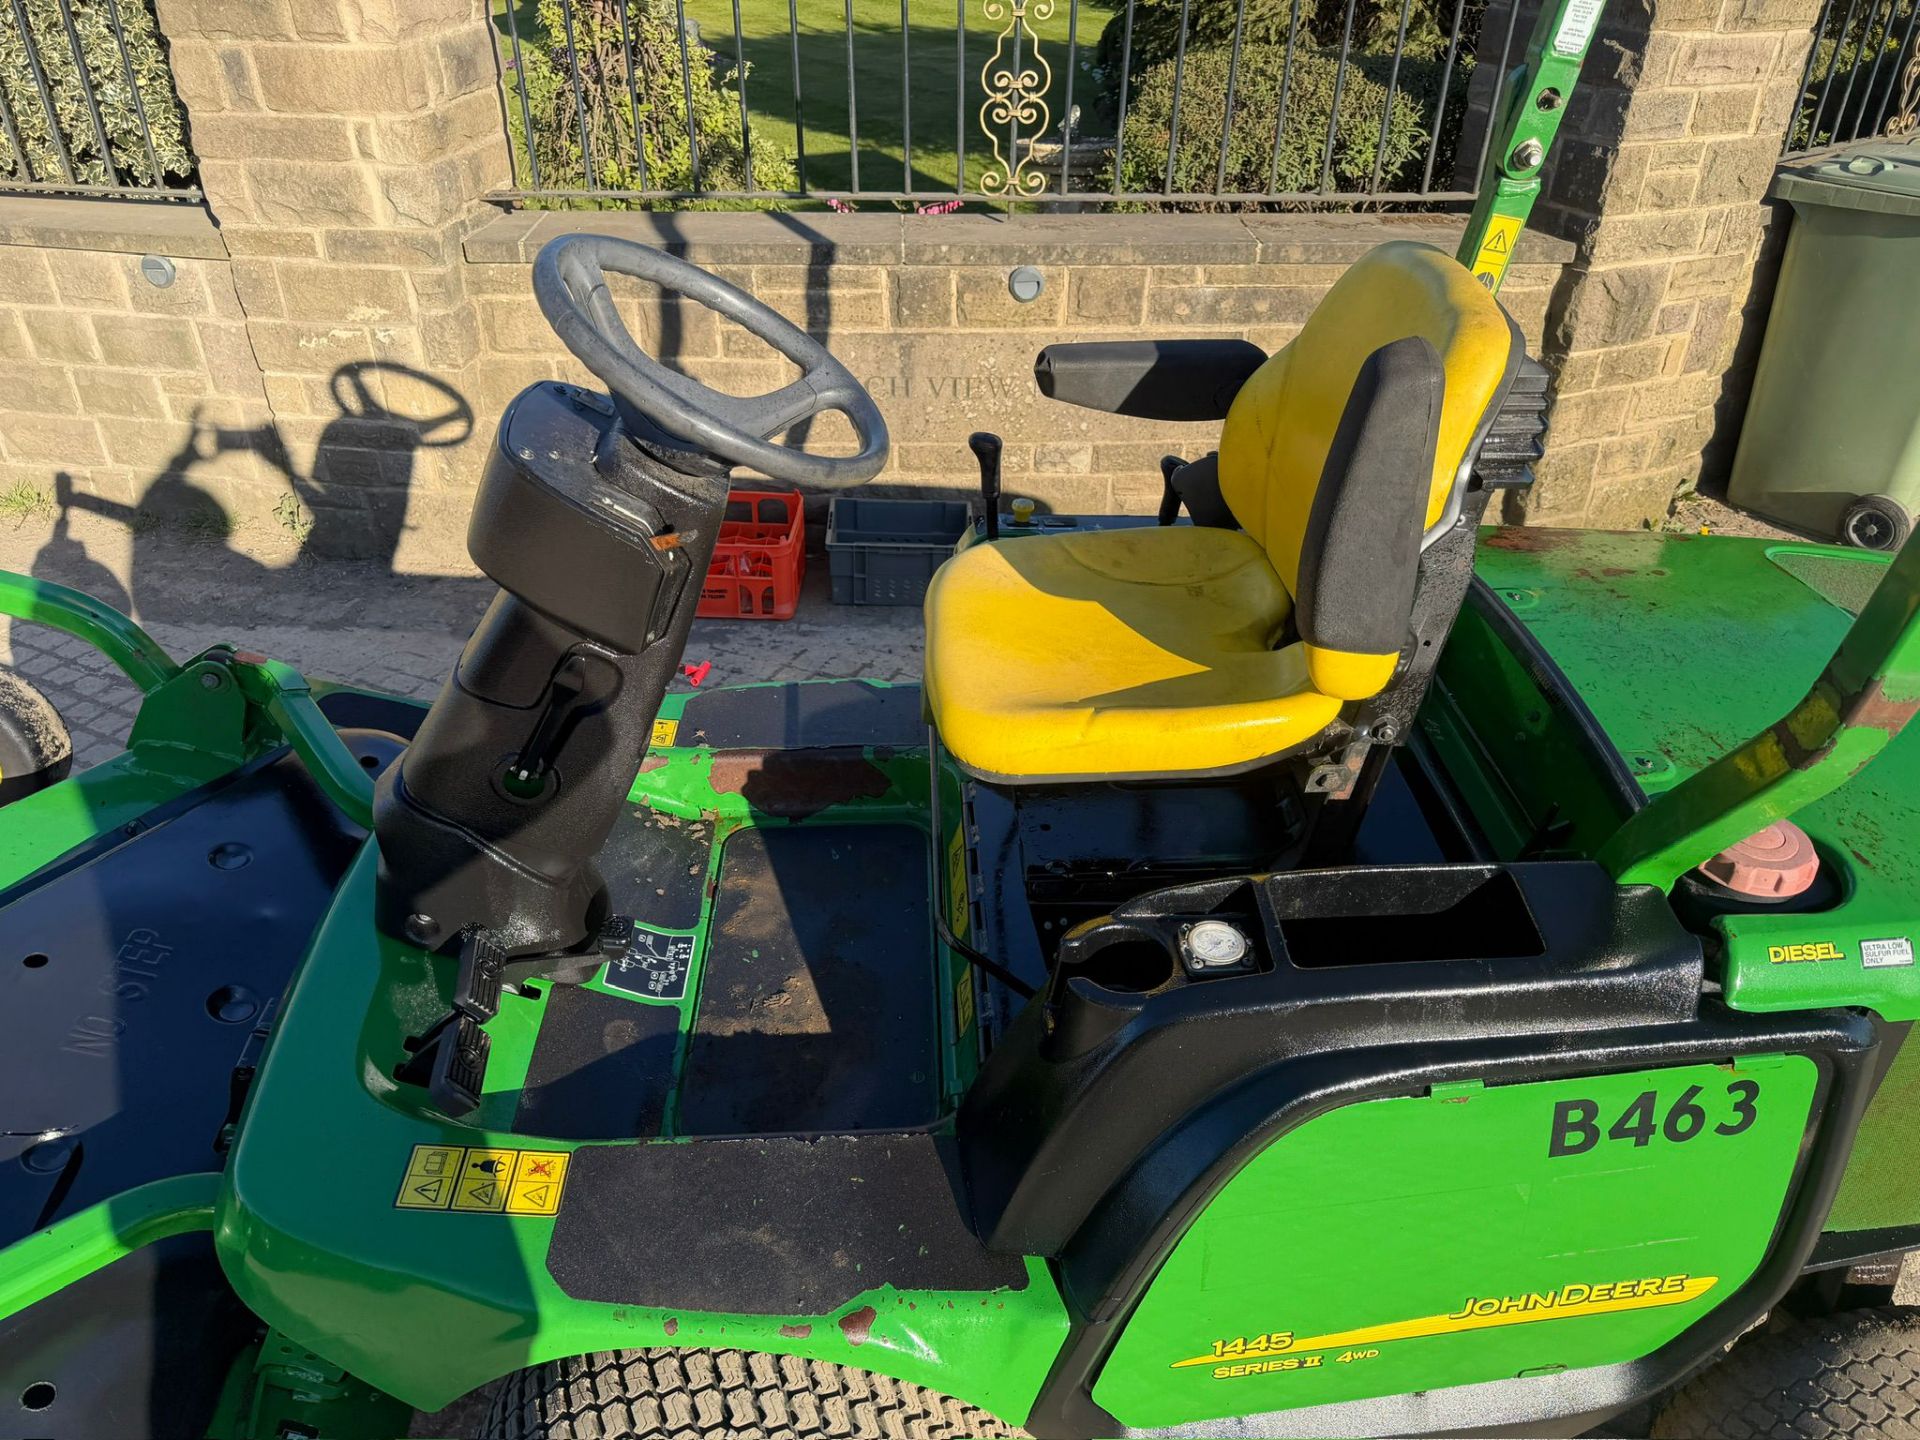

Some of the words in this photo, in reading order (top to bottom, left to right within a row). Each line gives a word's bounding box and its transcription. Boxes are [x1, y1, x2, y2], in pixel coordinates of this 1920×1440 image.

[866, 376, 912, 398] CH
[927, 376, 1016, 398] VIEW
[1768, 942, 1846, 964] DIESEL
[1864, 943, 1886, 951] ULTRA
[1887, 942, 1904, 950] LOW
[1865, 950, 1892, 958] SULFUR
[1893, 949, 1910, 957] FUEL
[1865, 957, 1884, 965] ONLY
[60, 1016, 127, 1057] NO
[97, 928, 173, 1001] STEP
[1548, 1079, 1760, 1158] B463
[1450, 1291, 1555, 1320] JOHN
[1559, 1274, 1690, 1308] DEERE
[1212, 1331, 1294, 1357] 1445
[1212, 1359, 1299, 1380] SERIES
[1303, 1355, 1324, 1369] II
[1336, 1348, 1380, 1365] 4WD
